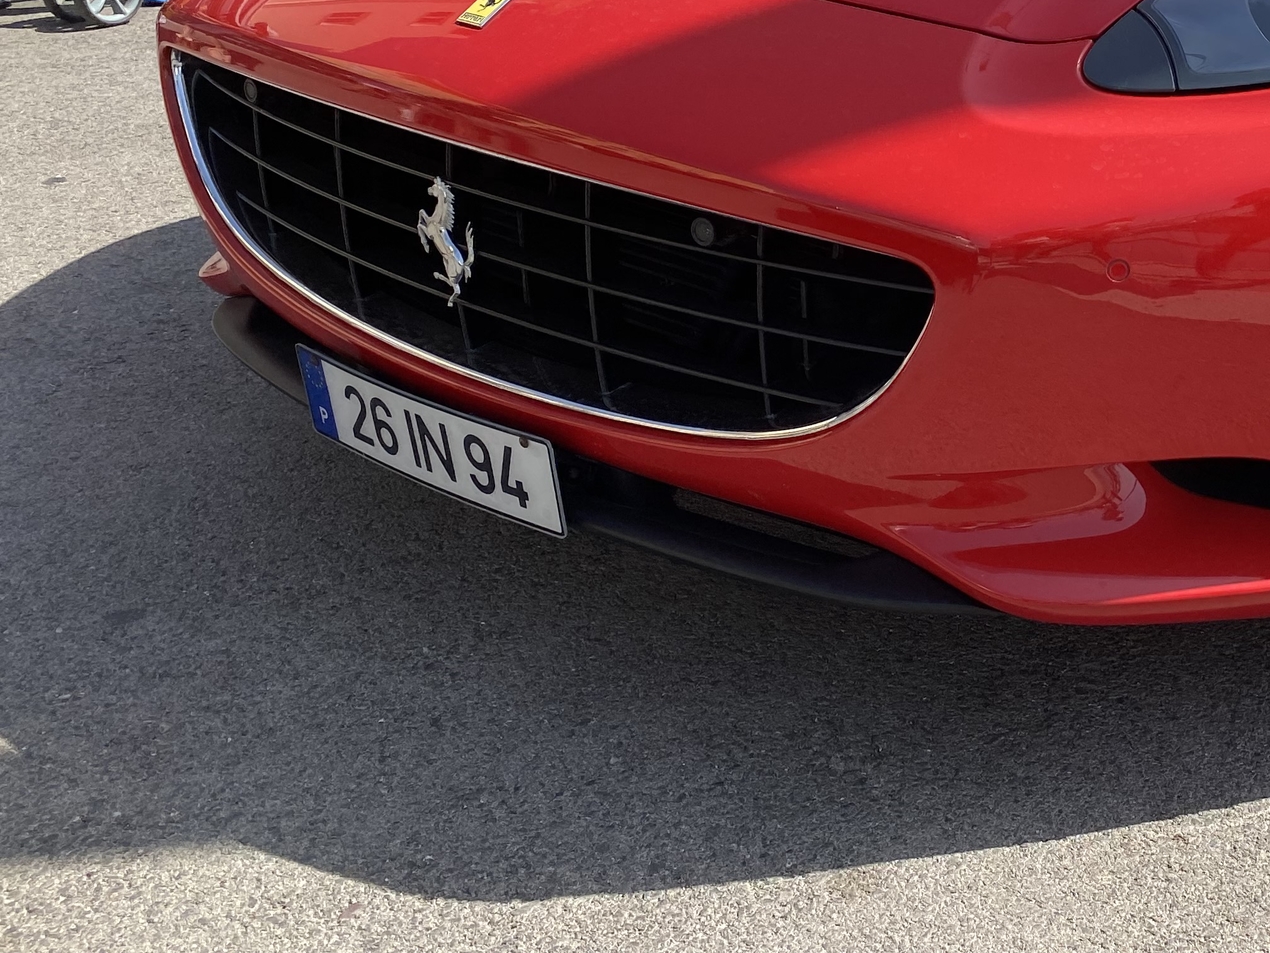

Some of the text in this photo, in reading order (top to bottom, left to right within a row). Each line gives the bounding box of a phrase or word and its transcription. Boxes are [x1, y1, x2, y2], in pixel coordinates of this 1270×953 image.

[319, 405, 329, 424] P
[344, 385, 529, 509] 26 IN 94
